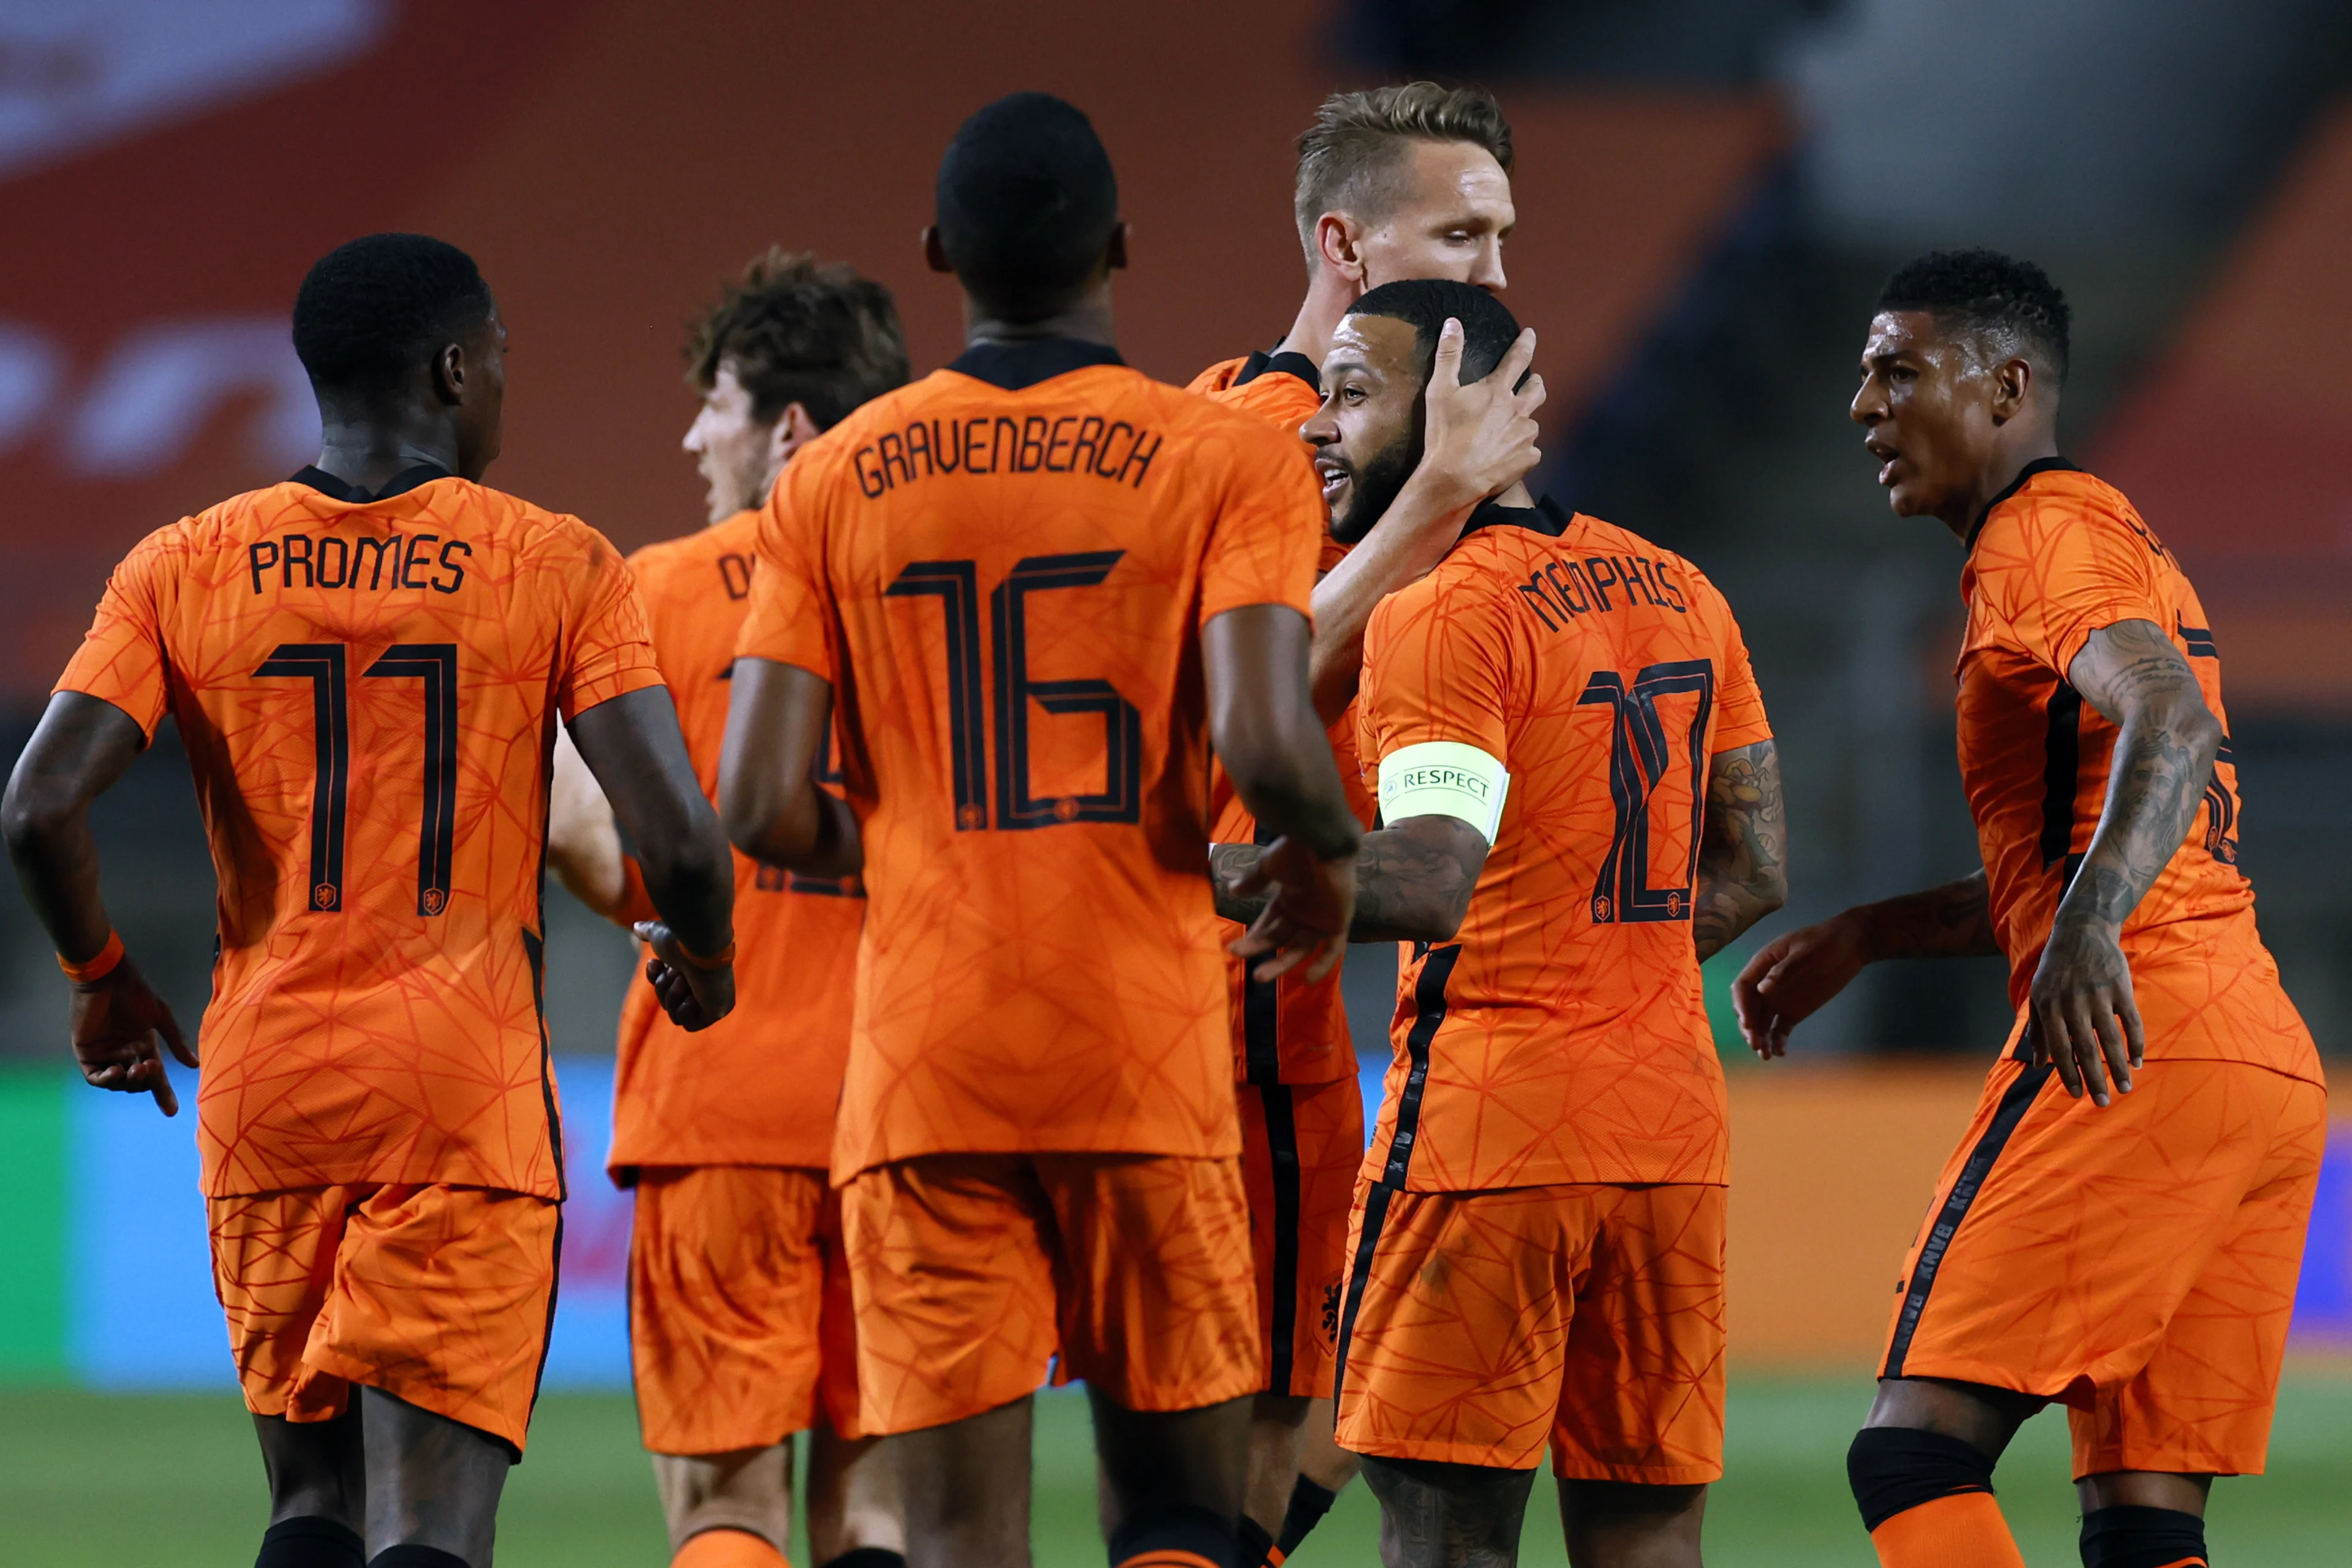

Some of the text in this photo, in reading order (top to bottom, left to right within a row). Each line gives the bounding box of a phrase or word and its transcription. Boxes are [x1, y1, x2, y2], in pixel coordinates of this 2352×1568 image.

[854, 416, 1163, 499] GRAVENBERCH
[250, 533, 472, 595] PROMES
[1518, 556, 1687, 633] MEMPHIS
[882, 549, 1140, 831] 16
[250, 643, 458, 916] 11
[1404, 770, 1489, 797] RESPECT
[1576, 658, 1714, 924] 10
[1917, 1223, 1953, 1279] KNVB
